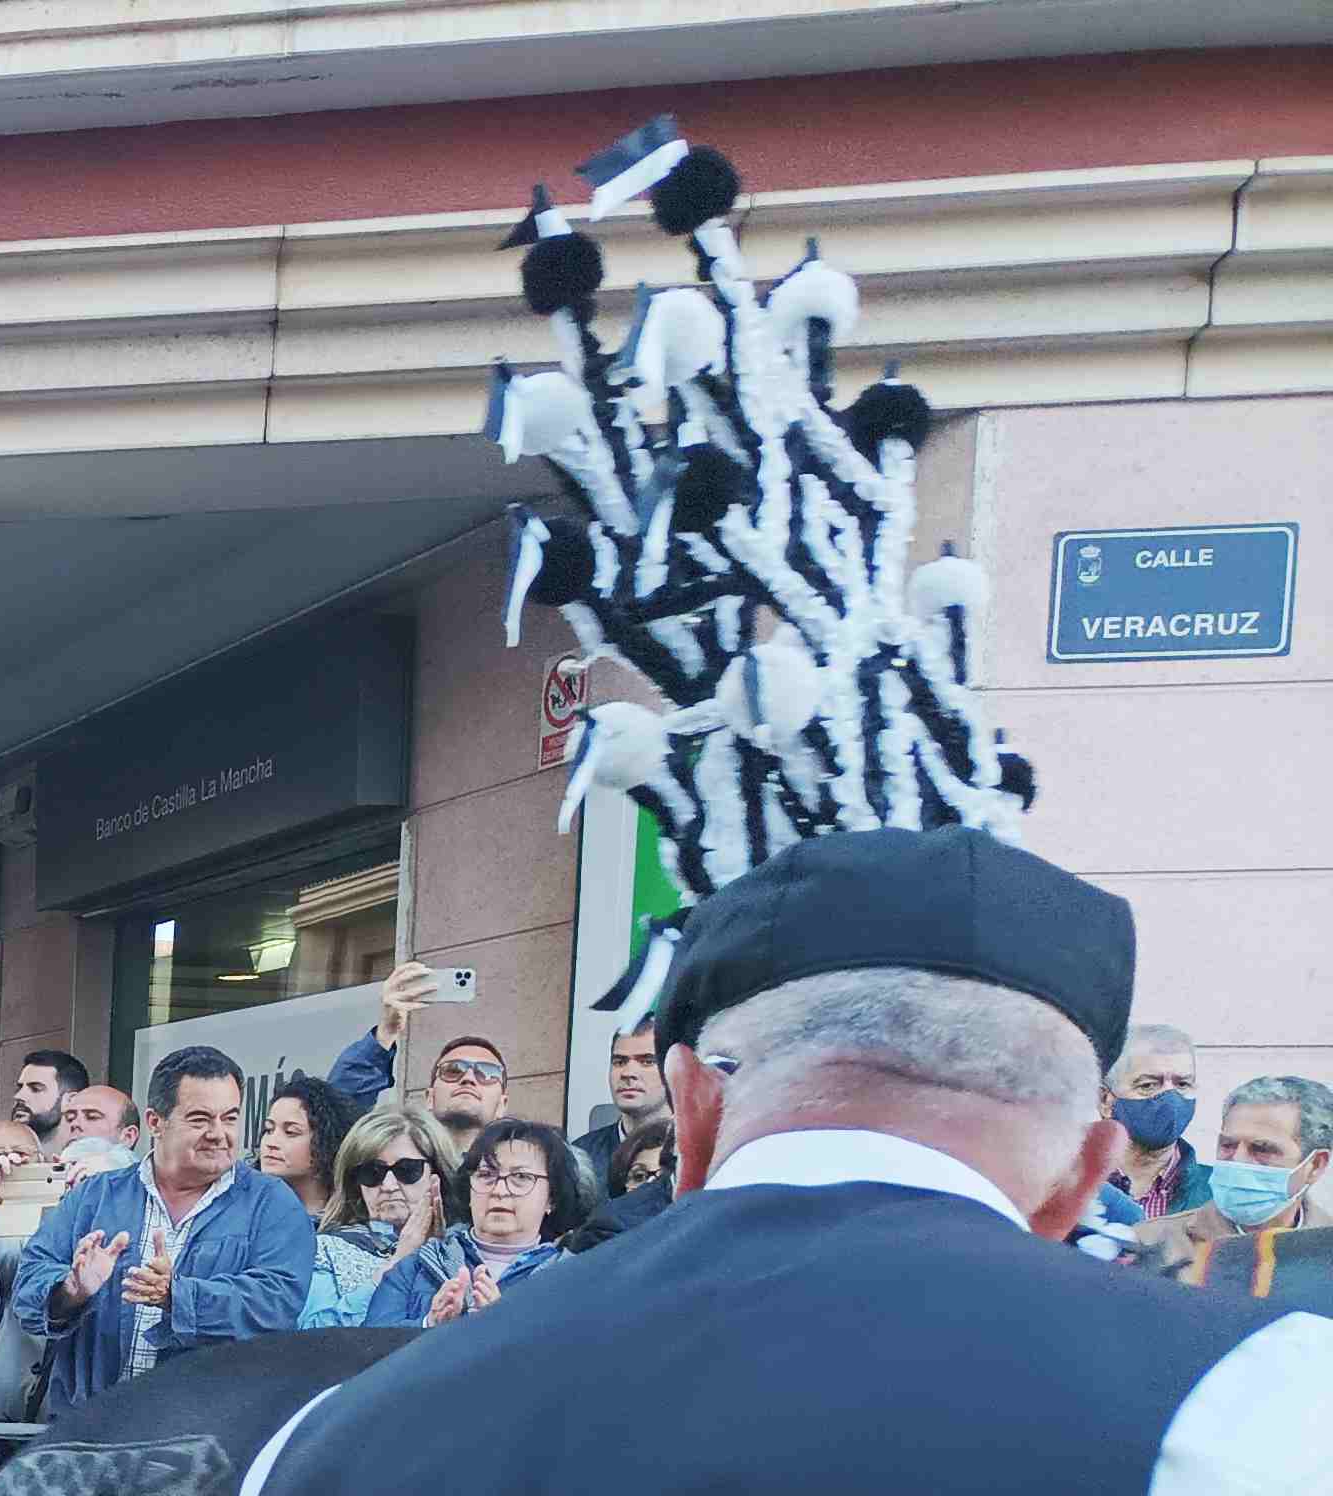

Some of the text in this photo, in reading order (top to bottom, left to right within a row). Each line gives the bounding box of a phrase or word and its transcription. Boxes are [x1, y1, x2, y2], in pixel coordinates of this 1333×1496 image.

[1135, 548, 1214, 568] CALLE
[1082, 611, 1260, 640] VERACRUZ
[96, 757, 274, 841] Banco de Castilla La Mancha
